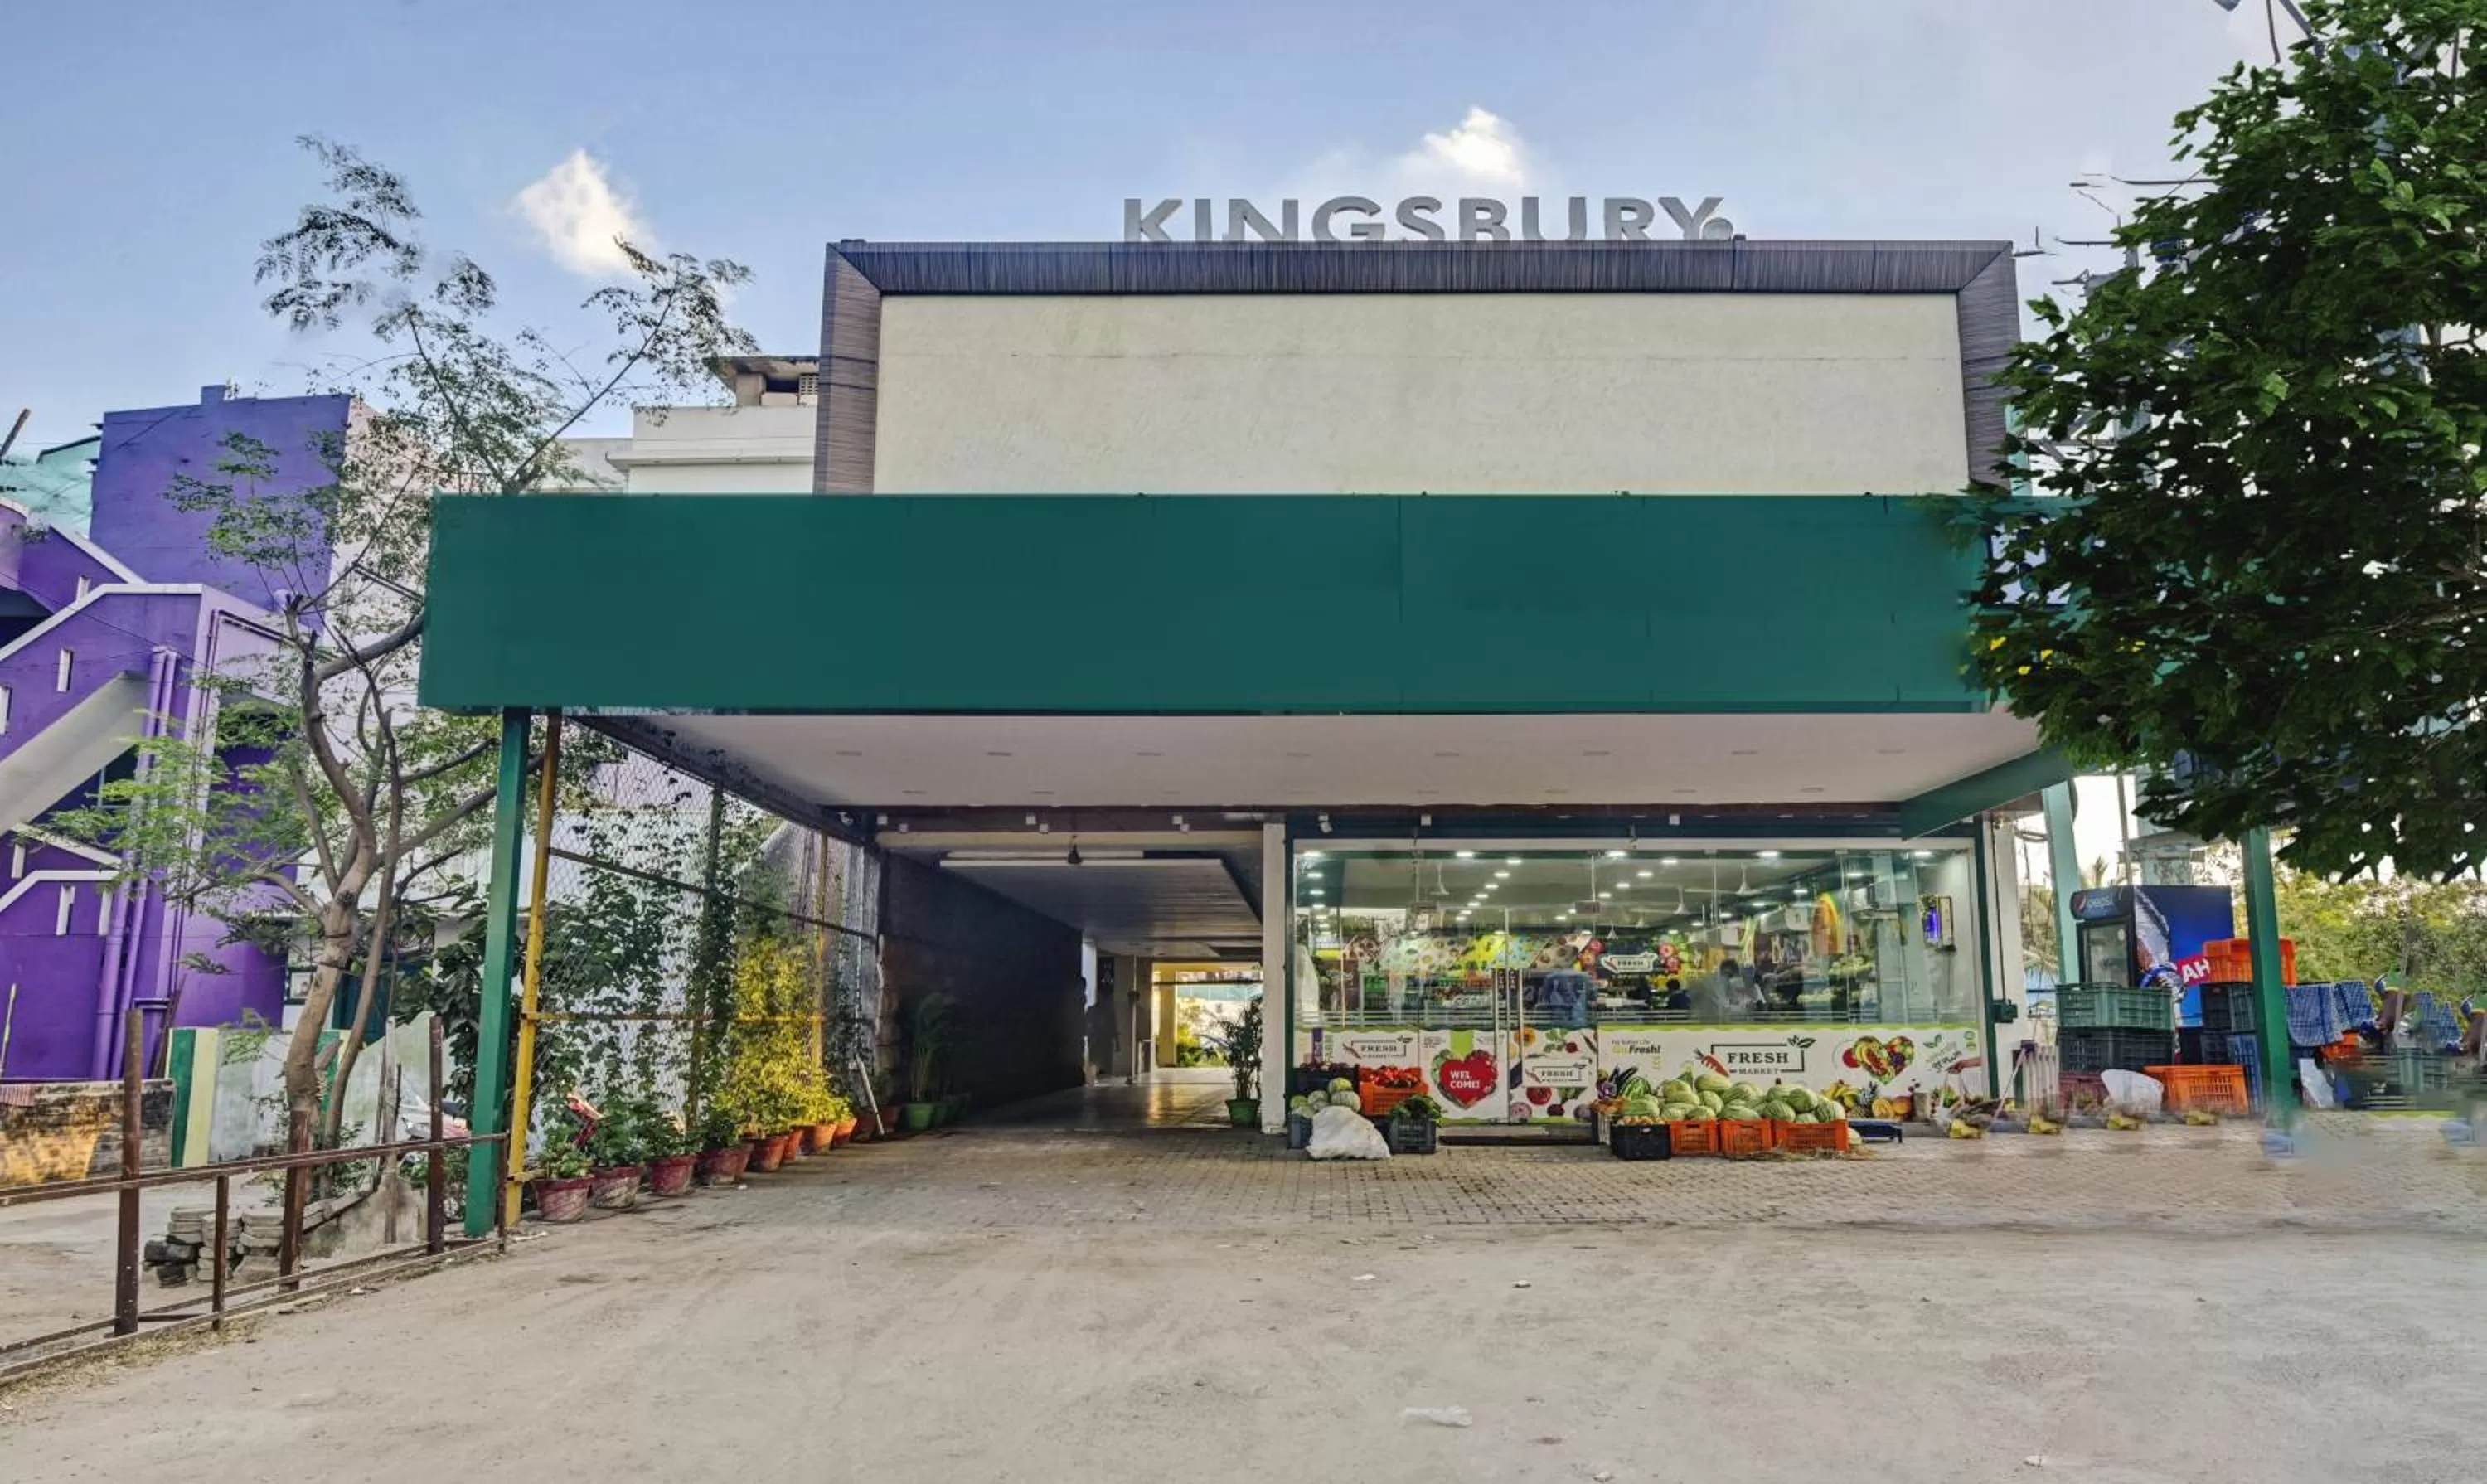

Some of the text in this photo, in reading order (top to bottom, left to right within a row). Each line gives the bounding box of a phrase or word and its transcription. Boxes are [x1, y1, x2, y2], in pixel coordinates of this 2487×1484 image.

[1123, 196, 1725, 243] KINGSBURY
[1629, 1045, 1661, 1054] Fresh!
[1727, 1052, 1789, 1064] FRESH
